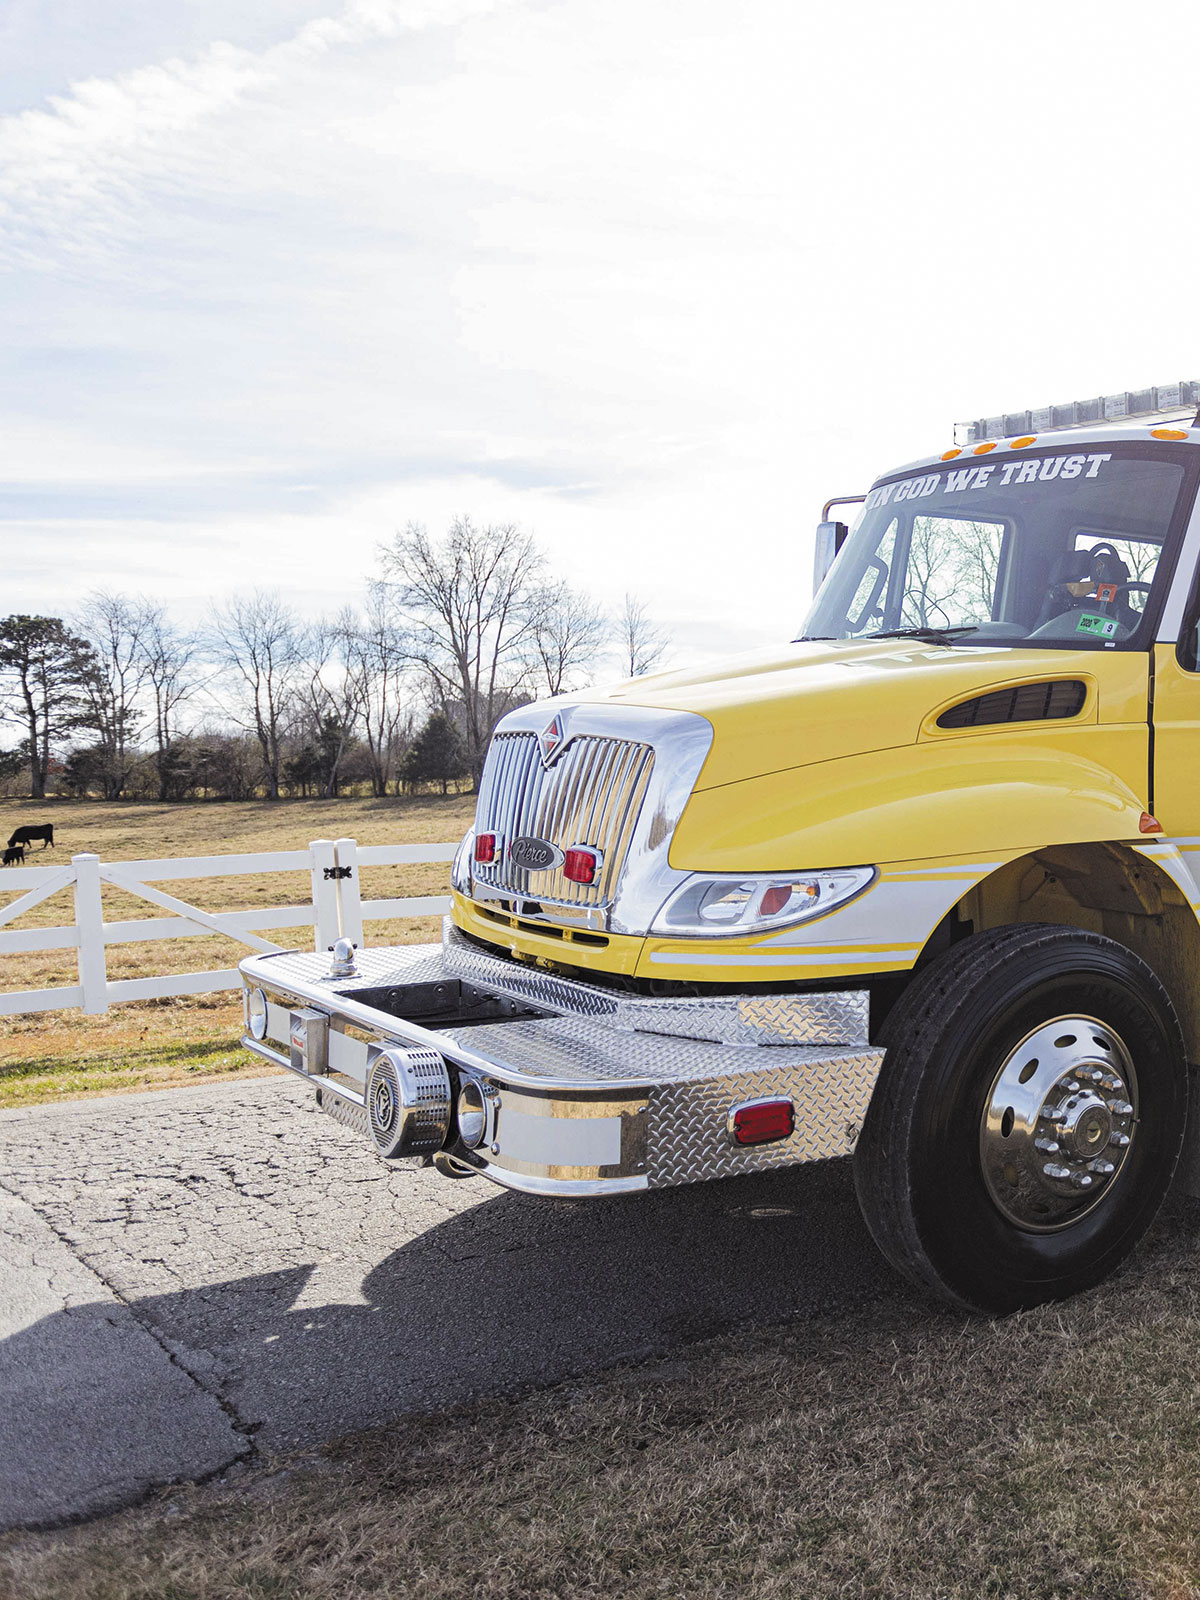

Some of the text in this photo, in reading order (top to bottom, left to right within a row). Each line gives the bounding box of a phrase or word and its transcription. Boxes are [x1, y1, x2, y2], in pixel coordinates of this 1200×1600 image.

[867, 453, 1112, 511] IN GOD WE TRUST
[515, 840, 547, 863] Pierce
